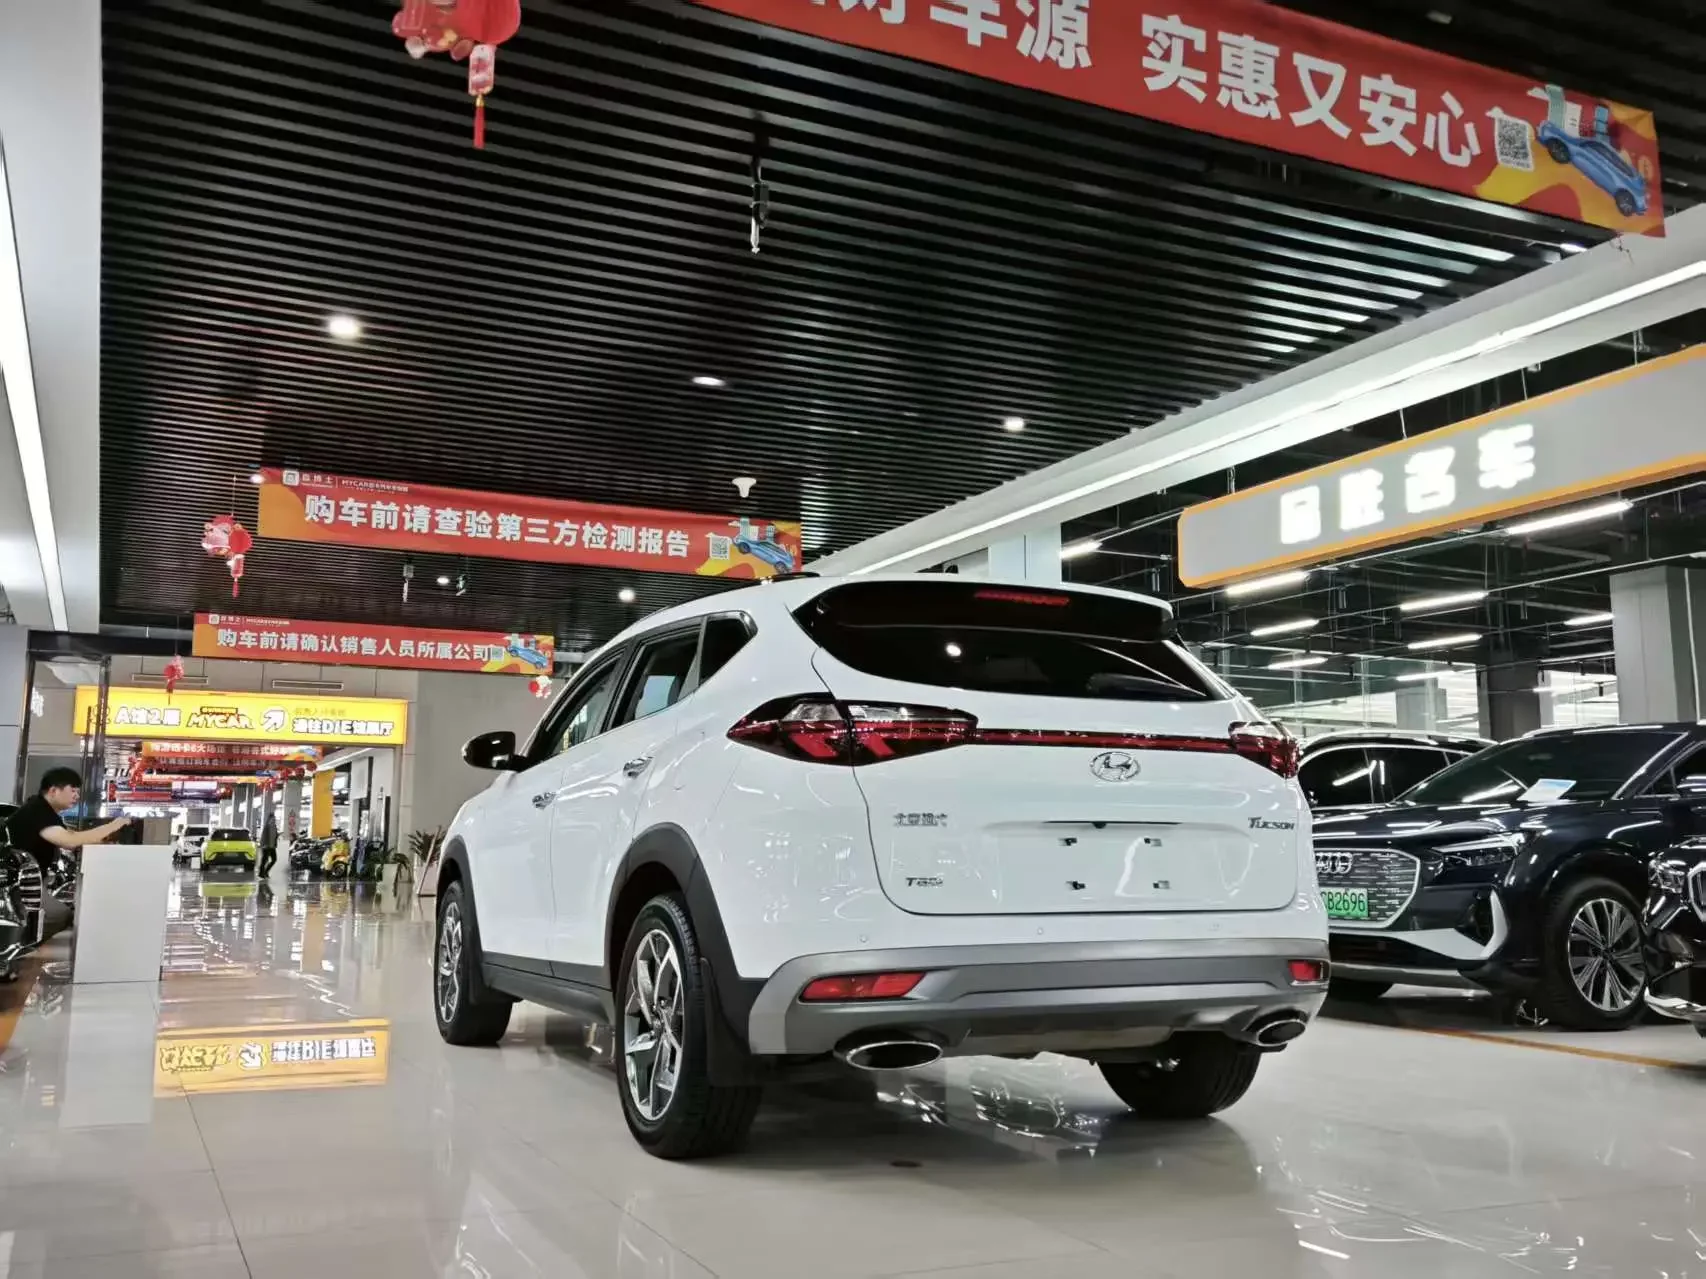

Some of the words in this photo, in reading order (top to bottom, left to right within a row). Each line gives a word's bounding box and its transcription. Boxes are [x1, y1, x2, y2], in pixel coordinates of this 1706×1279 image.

[1141, 14, 1481, 168] 实惠又安心
[305, 495, 690, 558] 购车前请查验第三方检测报告
[217, 628, 489, 662] 购车前请确认销售人员所属公司
